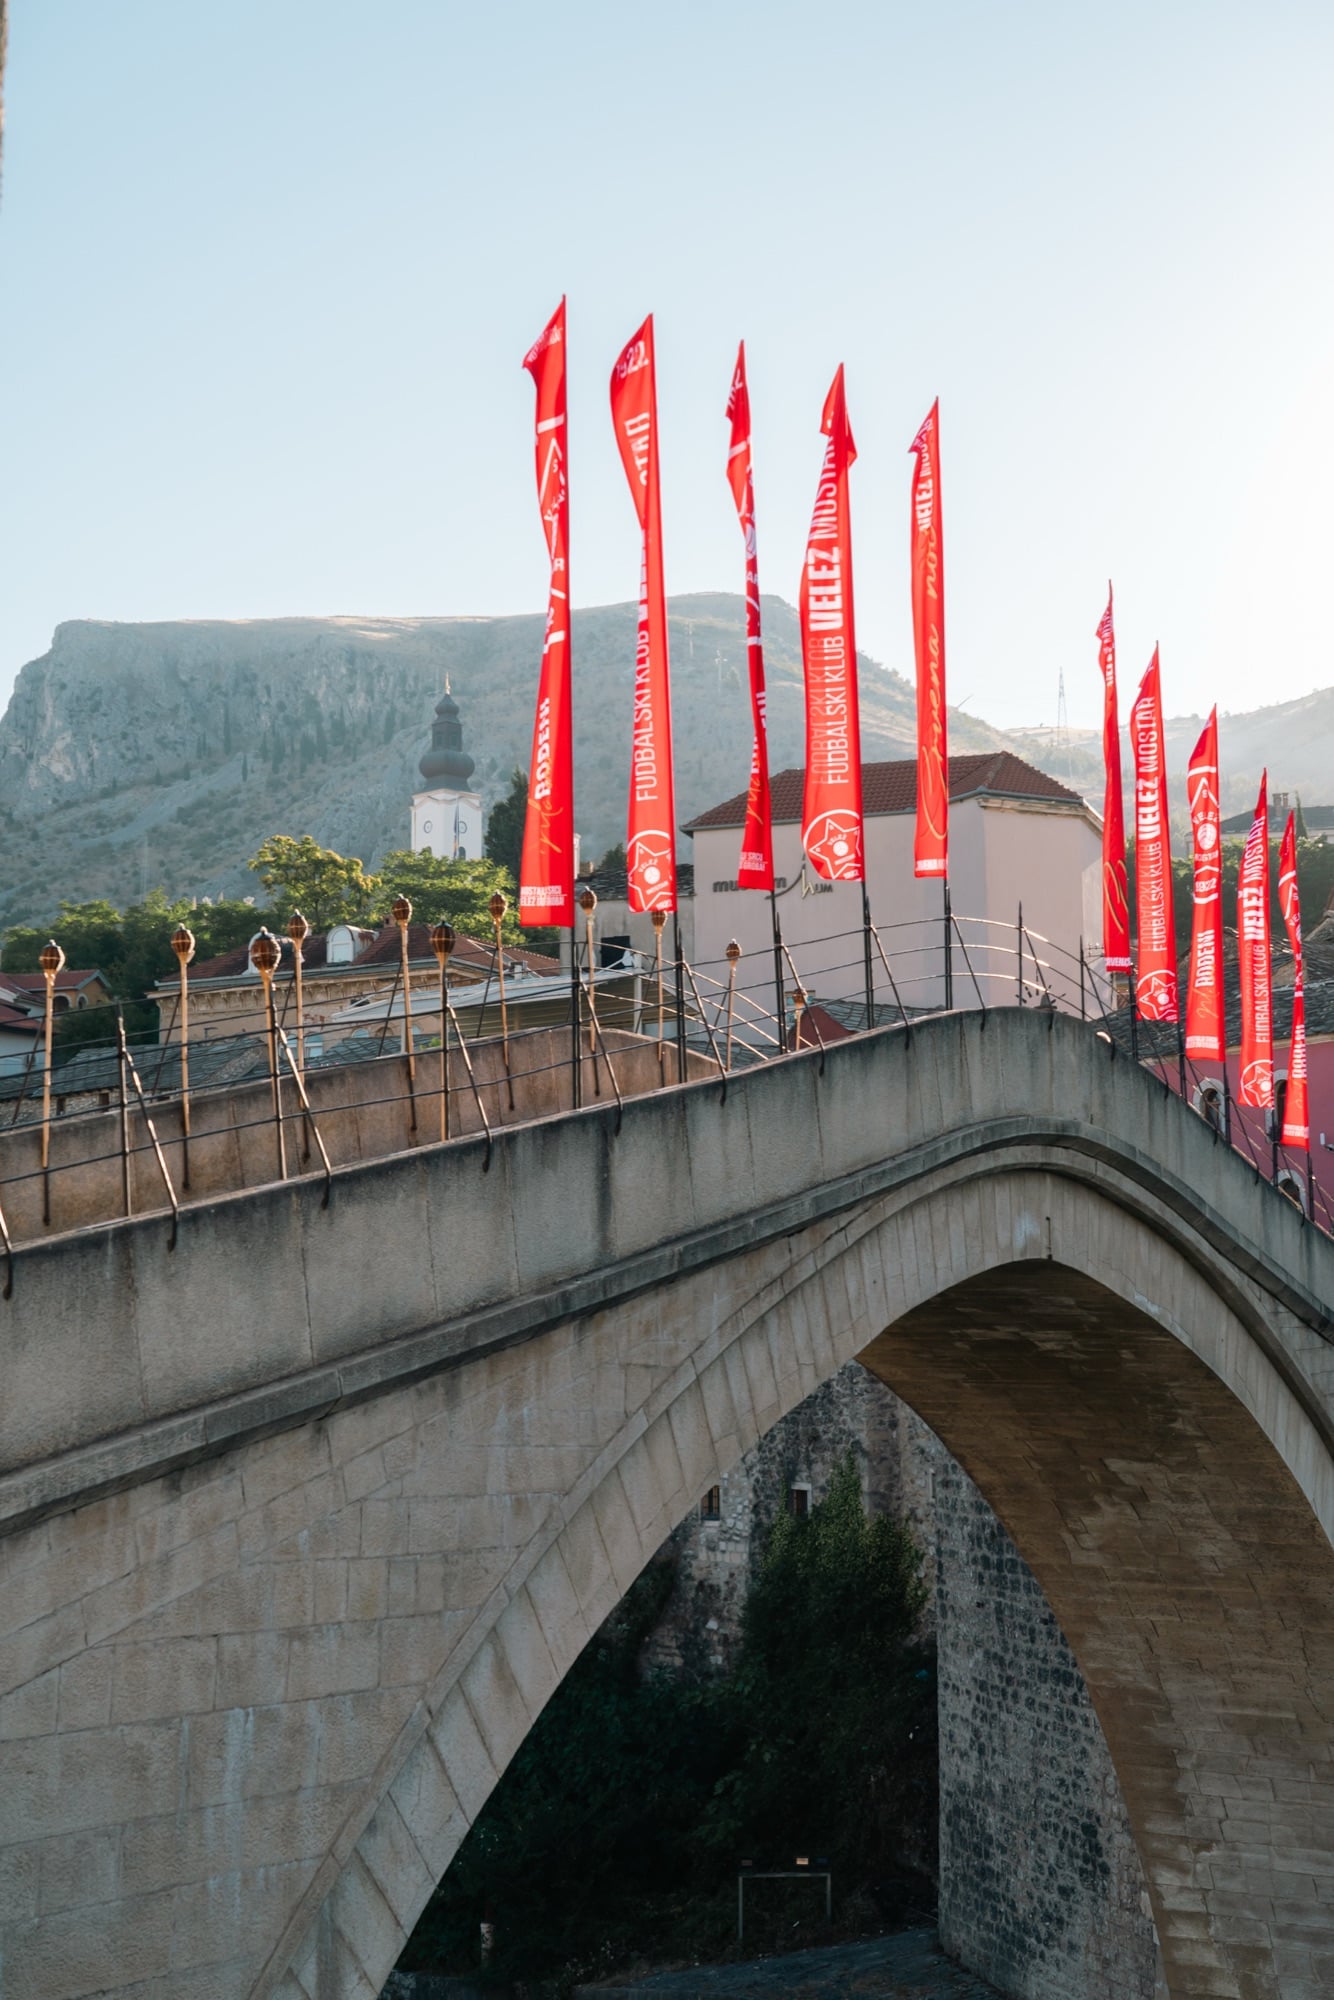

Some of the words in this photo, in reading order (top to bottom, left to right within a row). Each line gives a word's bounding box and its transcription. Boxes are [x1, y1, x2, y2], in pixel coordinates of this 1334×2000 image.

[823, 636, 846, 683] KLUB
[634, 688, 658, 801] FUDBALSKI
[825, 687, 849, 785] FUDBALSKI
[1135, 696, 1158, 773] MOSTAR
[1149, 841, 1163, 876] KLUB
[1243, 816, 1265, 884] MOSTAR
[1151, 879, 1168, 952] FUDBALSKI
[1252, 943, 1267, 976] KLUB
